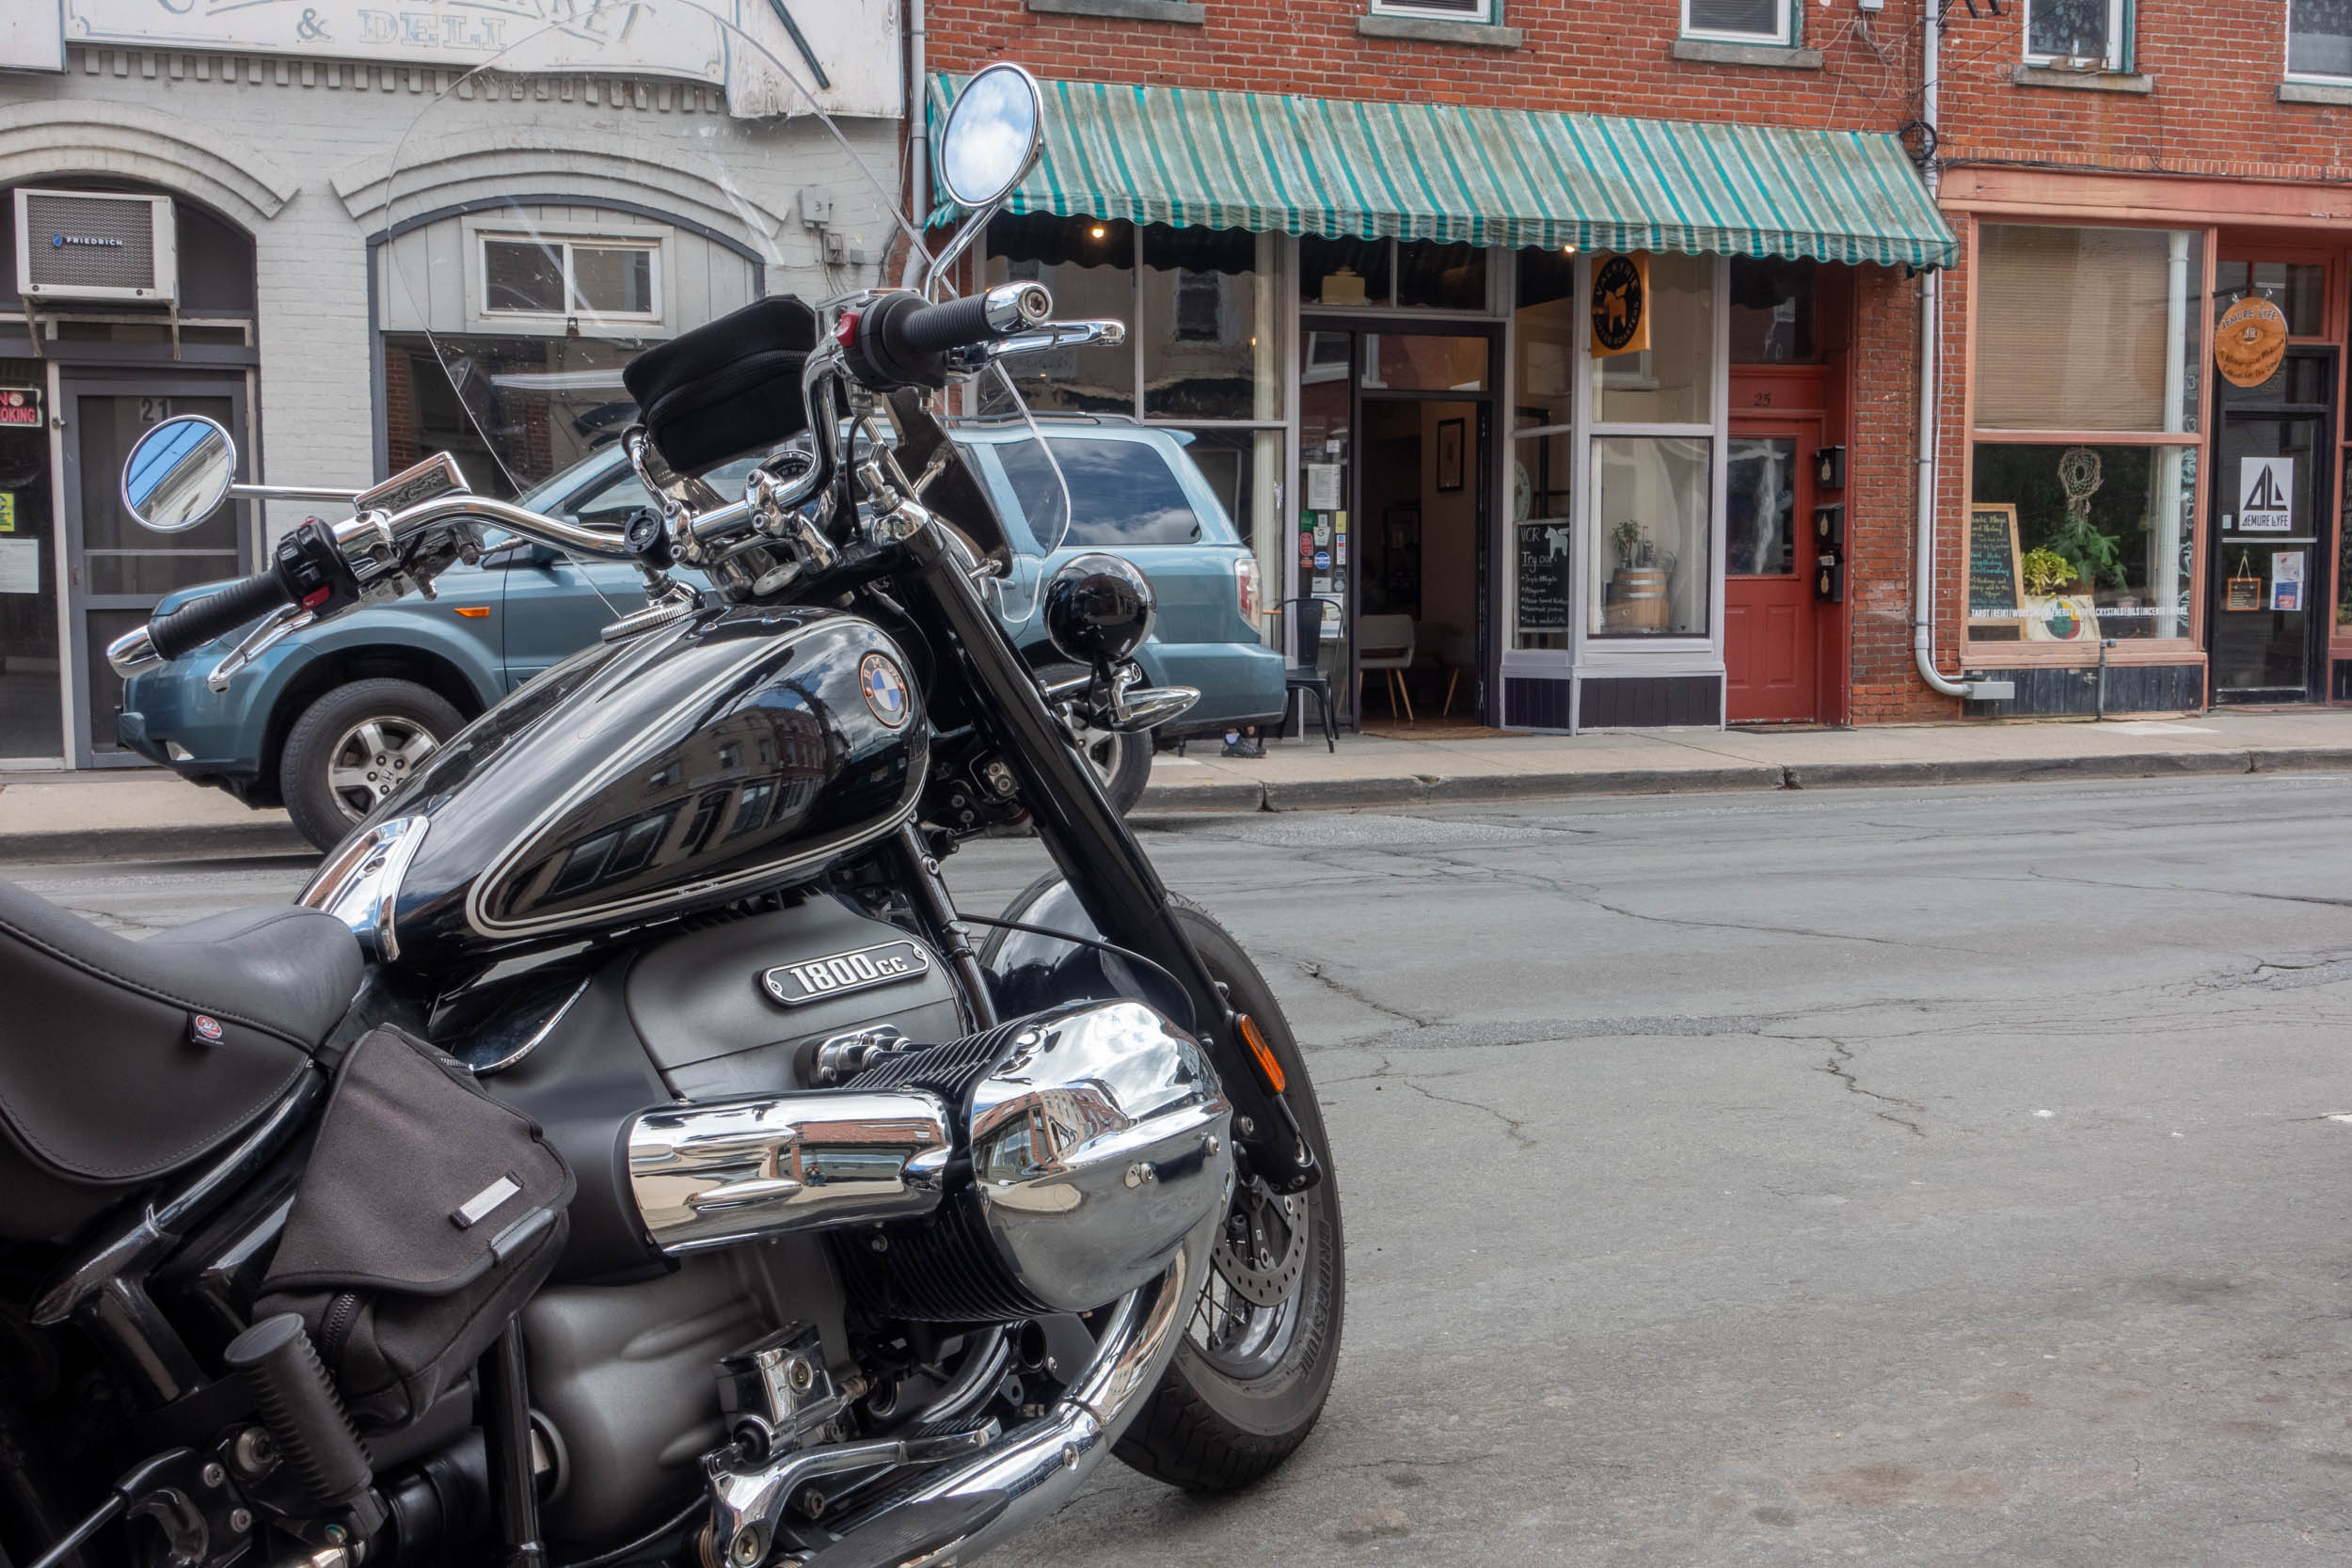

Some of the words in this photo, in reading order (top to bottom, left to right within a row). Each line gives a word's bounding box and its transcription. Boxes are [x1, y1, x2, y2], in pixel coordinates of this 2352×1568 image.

[296, 8, 333, 42] &
[358, 9, 506, 52] DELI
[66, 237, 123, 245] FRIEDRICH
[0, 408, 36, 422] OKING
[141, 399, 167, 422] 21
[1520, 527, 1541, 543] VCR
[1521, 551, 1538, 573] Try
[1971, 609, 1990, 618] TAROT
[1993, 609, 2009, 618] REIKI
[2095, 607, 2124, 616] CRYSTALS
[864, 657, 900, 684] BMW
[789, 954, 908, 993] 1800cc
[1300, 1219, 1332, 1384] BRIDGESTONE
